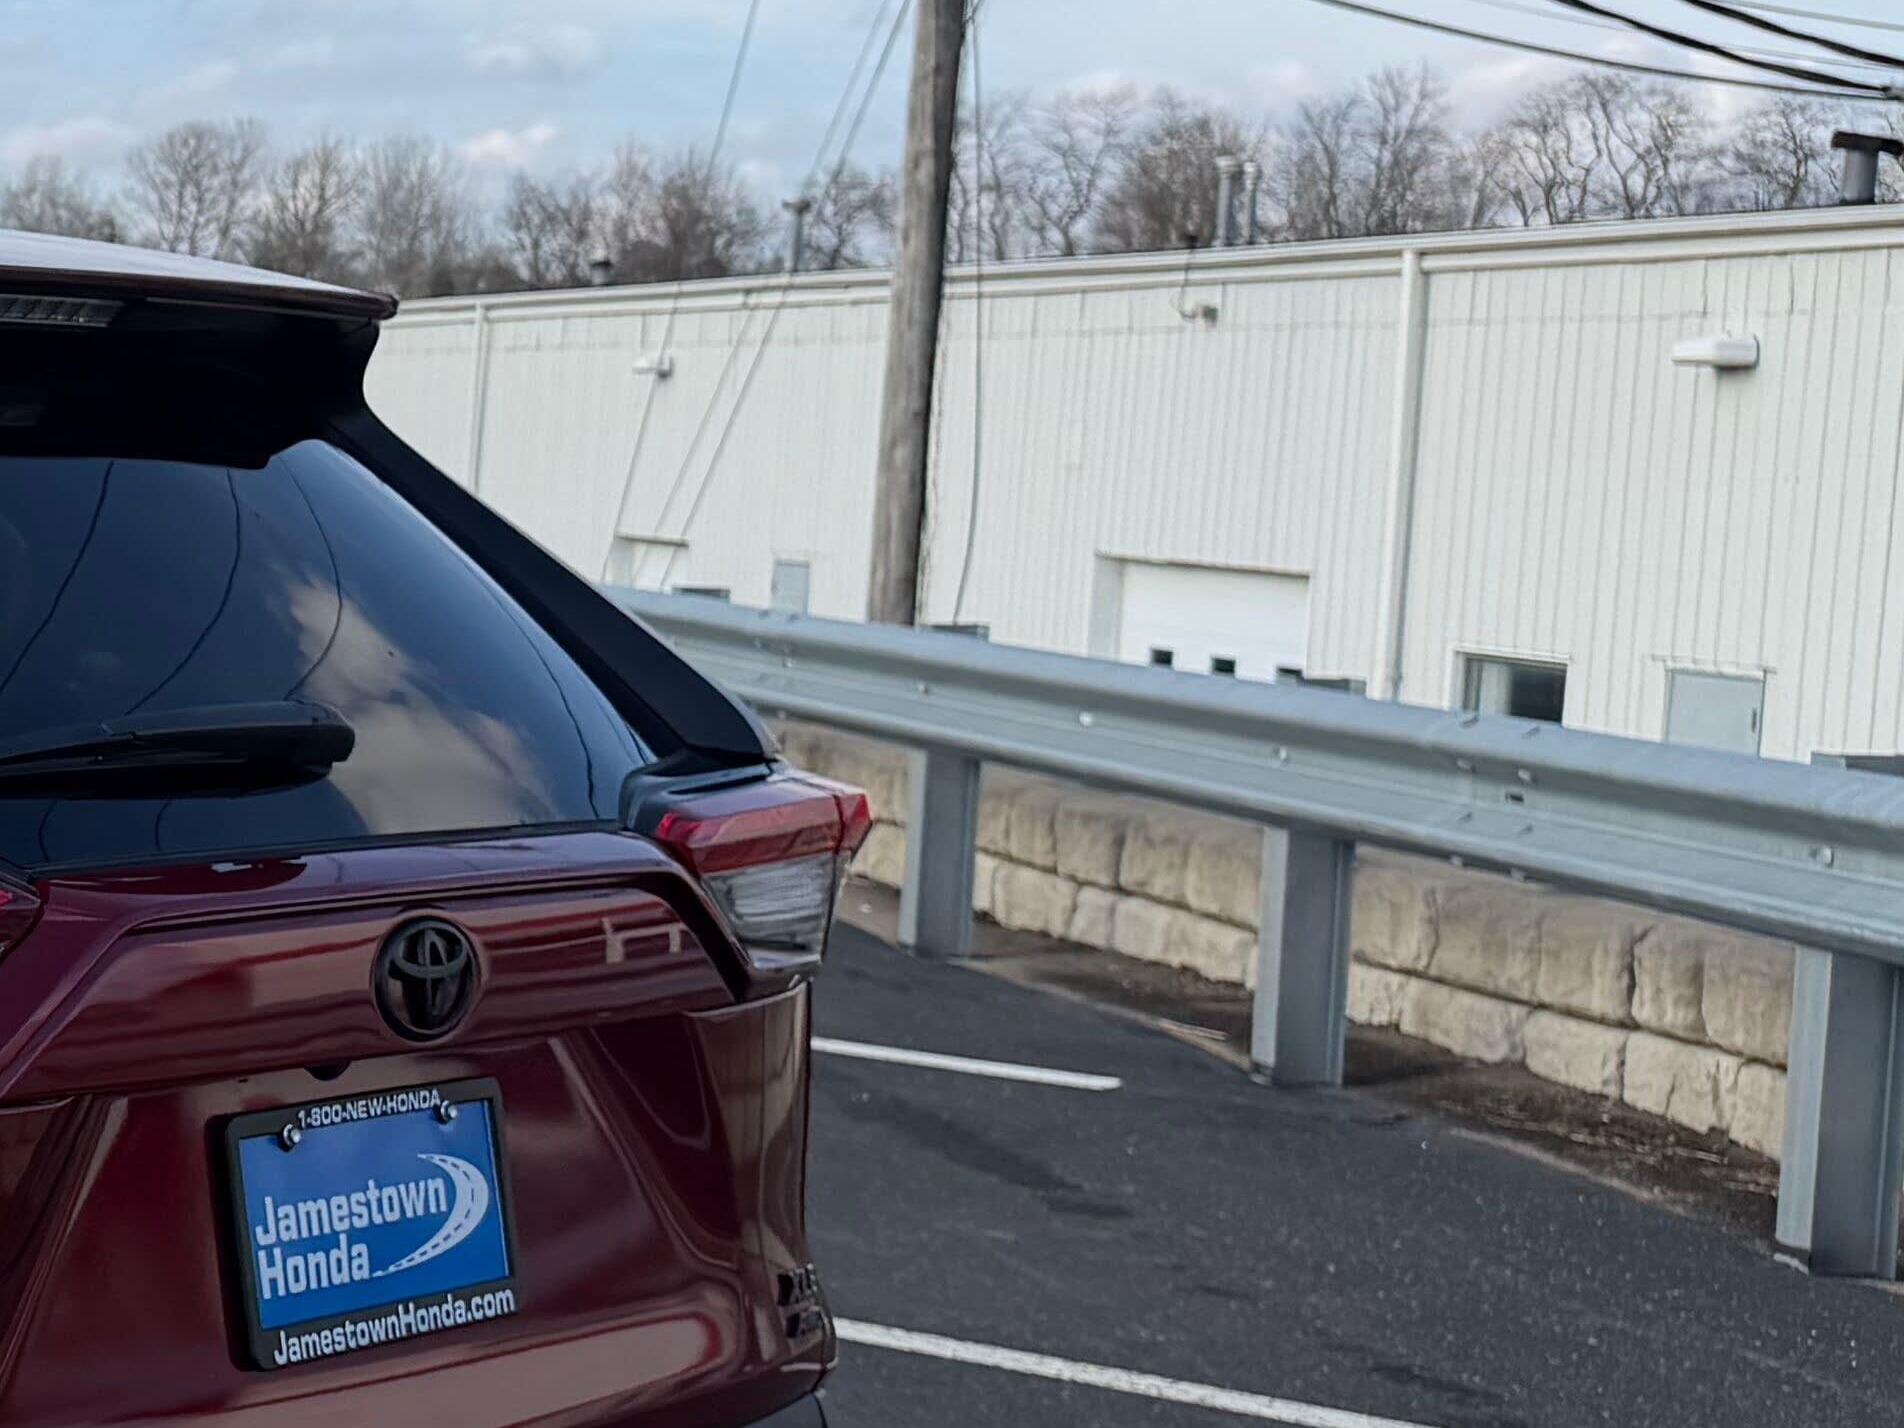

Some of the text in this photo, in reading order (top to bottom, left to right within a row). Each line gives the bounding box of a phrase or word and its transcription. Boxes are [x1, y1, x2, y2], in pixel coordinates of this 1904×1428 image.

[297, 1088, 442, 1129] 1-800-NEW-HONDA
[255, 1177, 448, 1246] Jamestown
[257, 1233, 371, 1301] Honda
[273, 1287, 516, 1366] JamestownHonda.com
